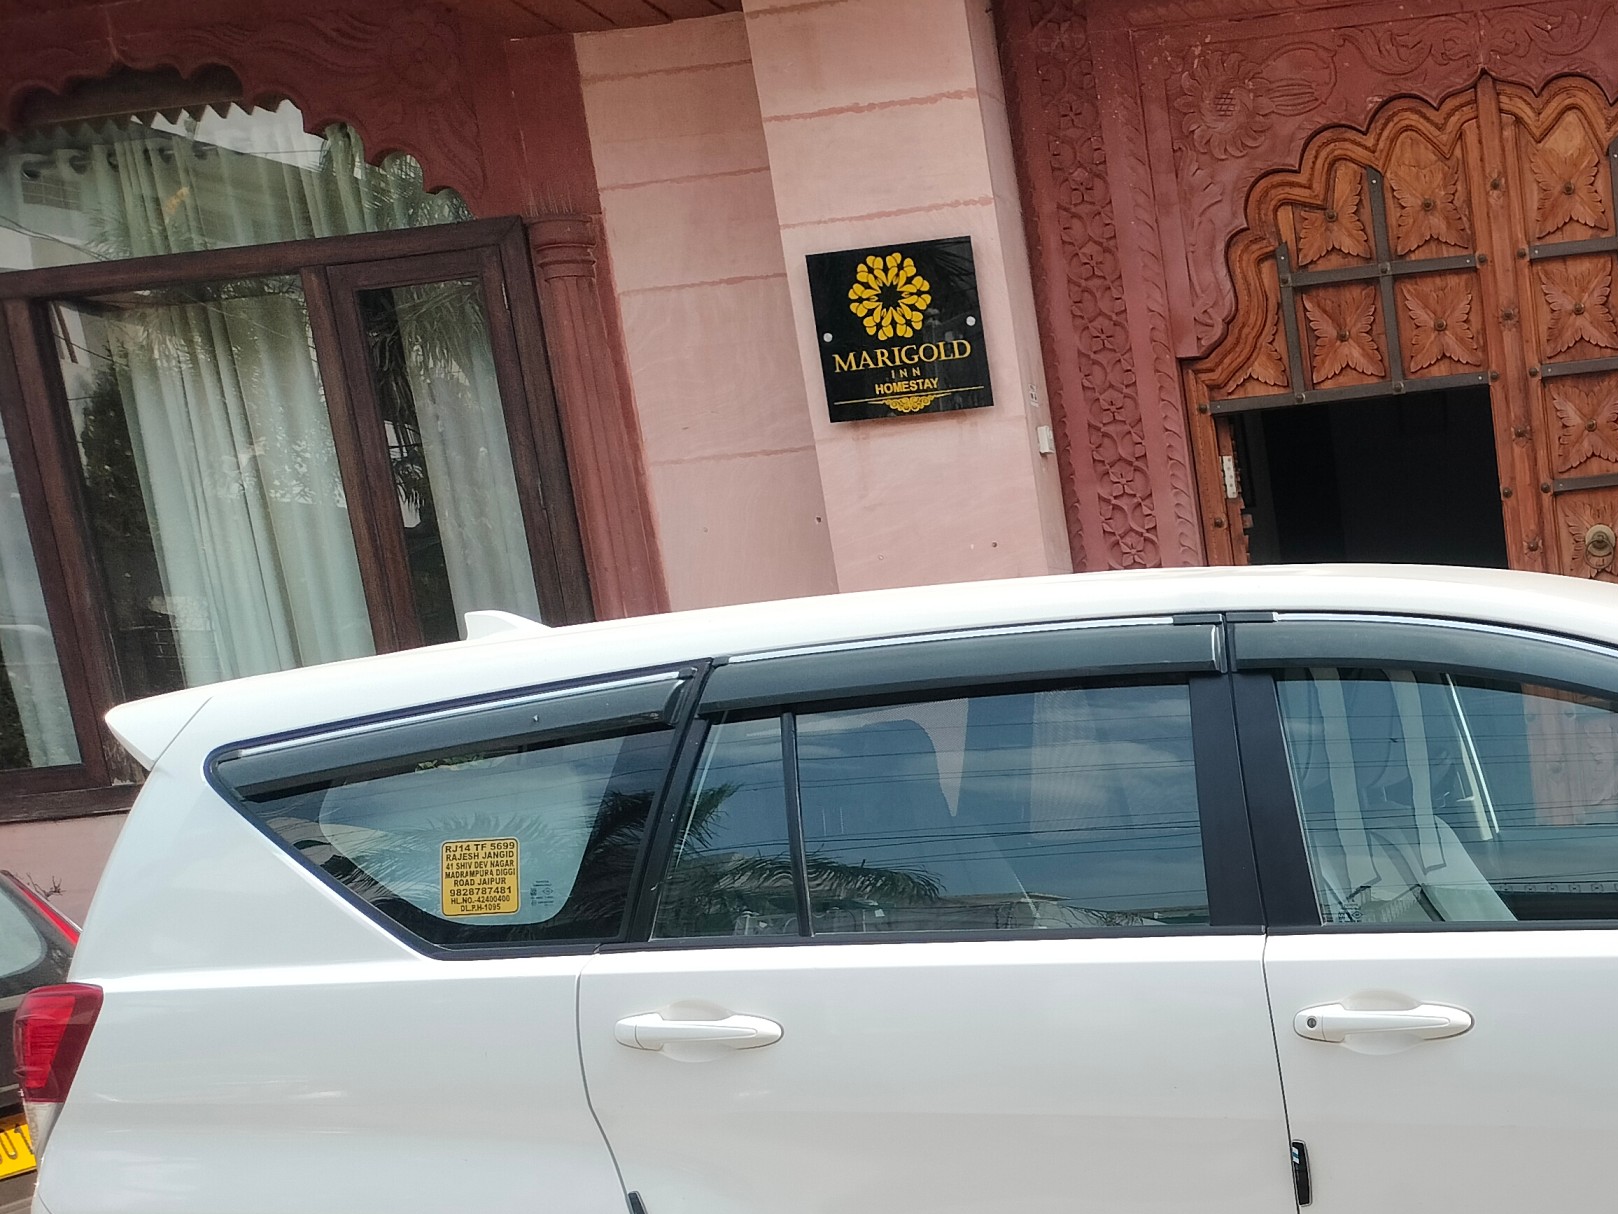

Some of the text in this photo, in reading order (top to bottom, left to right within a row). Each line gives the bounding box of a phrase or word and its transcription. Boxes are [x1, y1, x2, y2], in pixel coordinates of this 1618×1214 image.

[832, 339, 971, 373] MARIGOLD
[891, 366, 921, 379] INN
[875, 377, 939, 395] HOMESTAY
[445, 842, 515, 853] RJ14 TF 5699
[446, 850, 514, 862] RAJESH JANGID
[445, 859, 514, 870] 41 SHIV DEV NAGAR
[445, 868, 516, 879] MADRAMPURA DIGGI
[453, 877, 507, 887] ROAD JAIPUR
